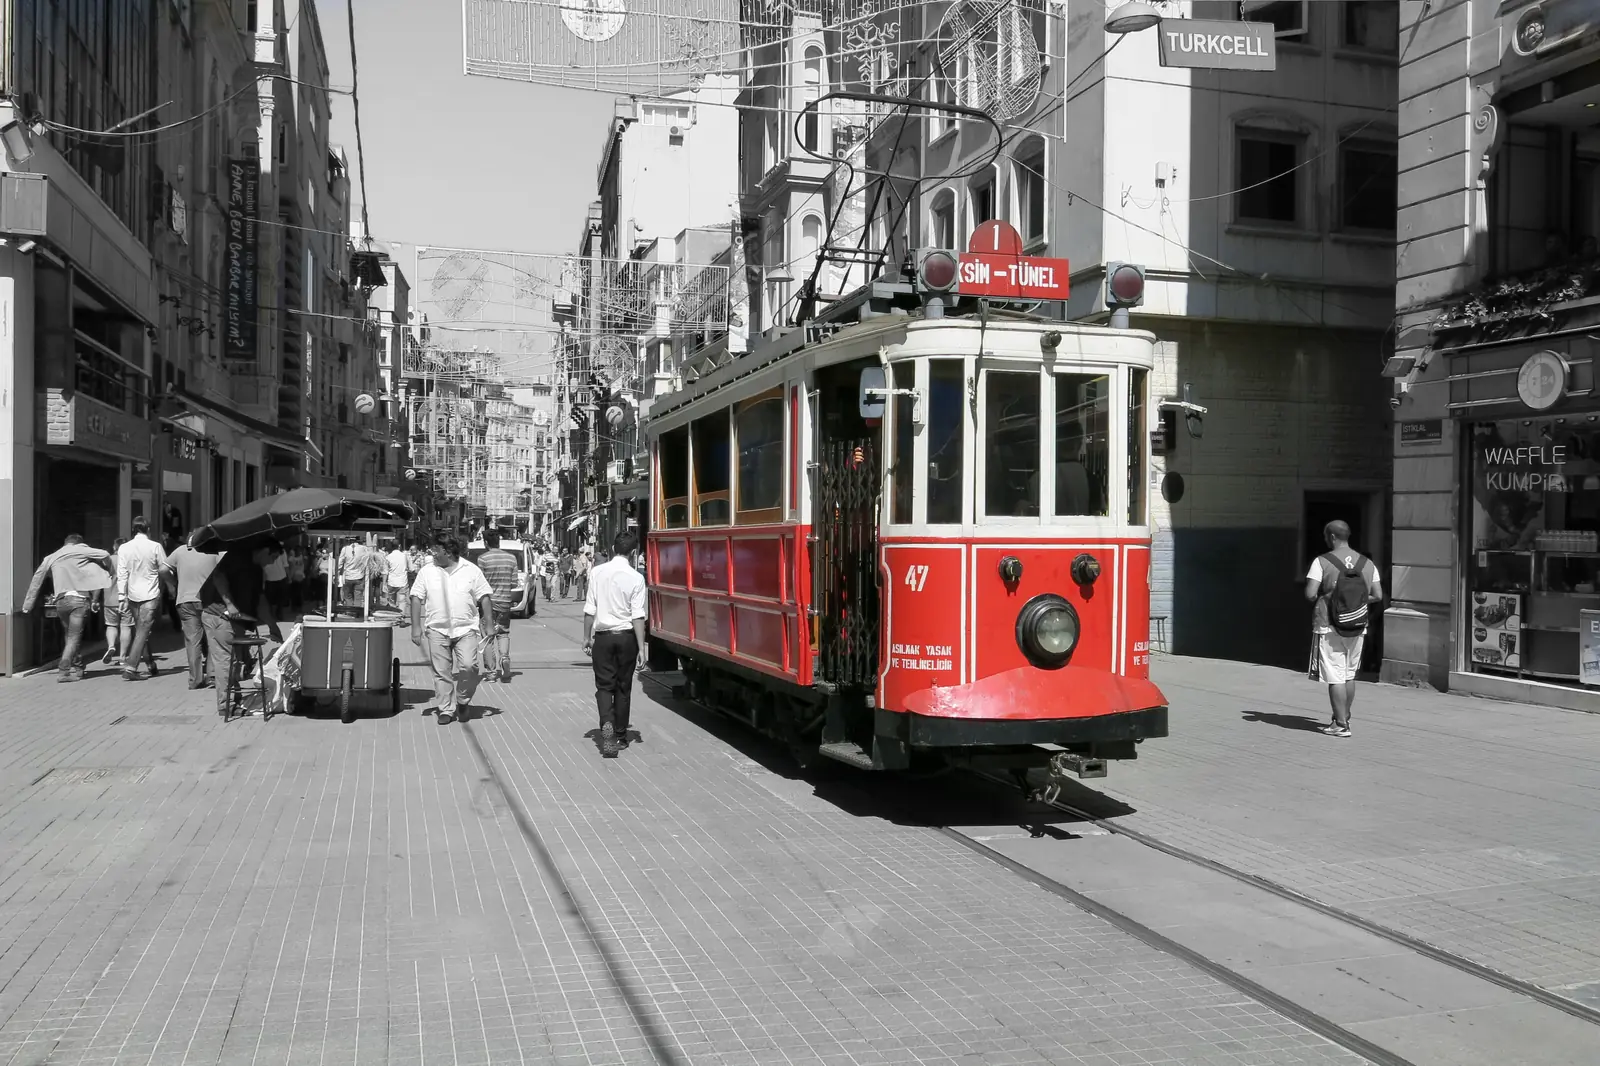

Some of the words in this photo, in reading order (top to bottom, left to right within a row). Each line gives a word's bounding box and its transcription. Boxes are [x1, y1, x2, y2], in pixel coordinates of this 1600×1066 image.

[1166, 31, 1269, 56] TURKCELL
[230, 164, 245, 205] ANNE,
[229, 210, 243, 239] BEN
[992, 224, 999, 251] 1
[228, 242, 243, 290] BARBAR
[1008, 261, 1059, 288] TÜNEL
[1484, 445, 1567, 465] WAFFLE
[904, 565, 929, 592] 47
[891, 643, 920, 655] ASILMAK
[926, 645, 952, 656] YASAK
[891, 657, 900, 668] VE
